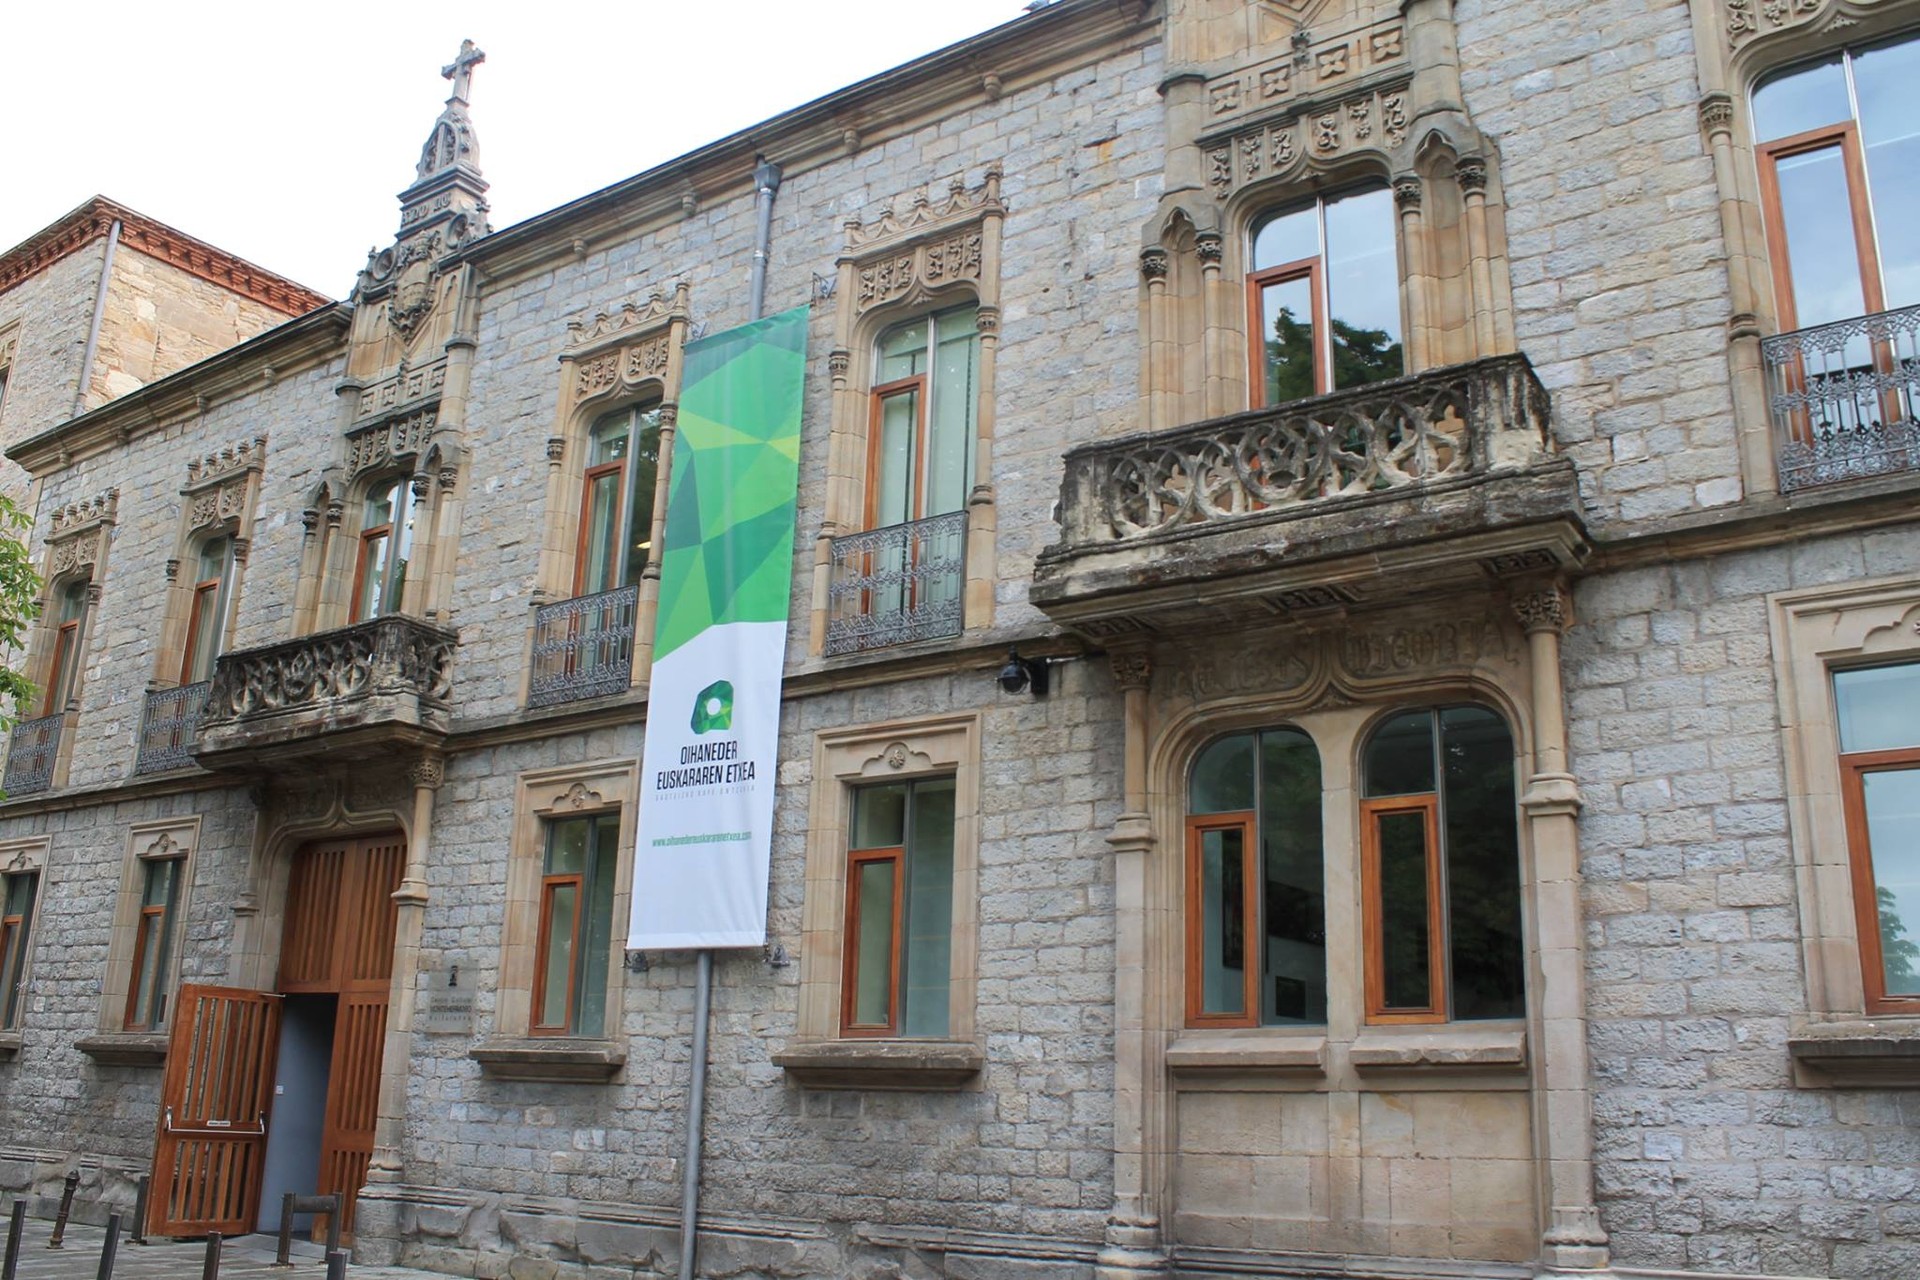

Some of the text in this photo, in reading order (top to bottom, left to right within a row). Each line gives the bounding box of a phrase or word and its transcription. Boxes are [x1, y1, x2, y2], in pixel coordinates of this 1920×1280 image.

[680, 741, 738, 765] OIHANEDER
[657, 762, 755, 790] EUSKARAREN ETXEA
